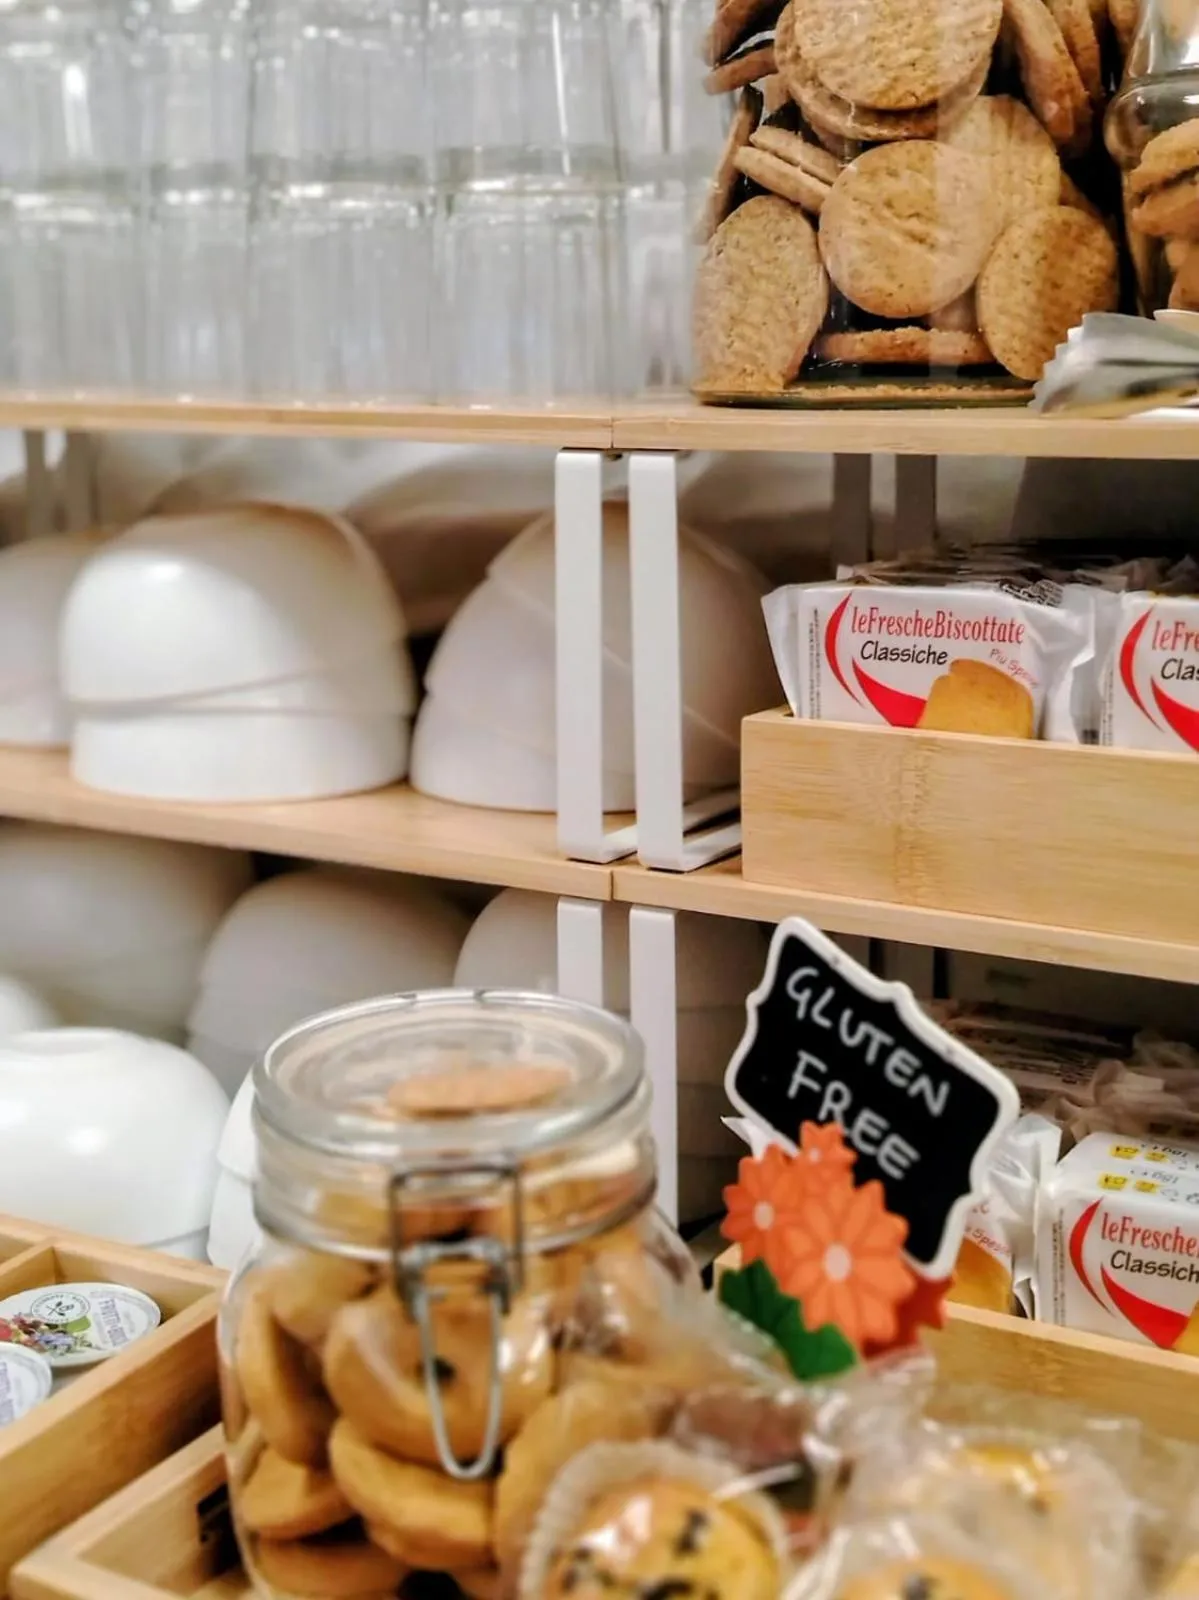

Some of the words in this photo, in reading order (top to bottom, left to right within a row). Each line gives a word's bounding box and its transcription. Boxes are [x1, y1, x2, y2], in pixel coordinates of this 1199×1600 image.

[851, 606, 1025, 644] leFrescheBiscottate
[860, 640, 948, 665] Classiche
[786, 966, 950, 1117] GLUTEN
[787, 1050, 921, 1180] FREE
[1101, 1212, 1199, 1258] leFresche
